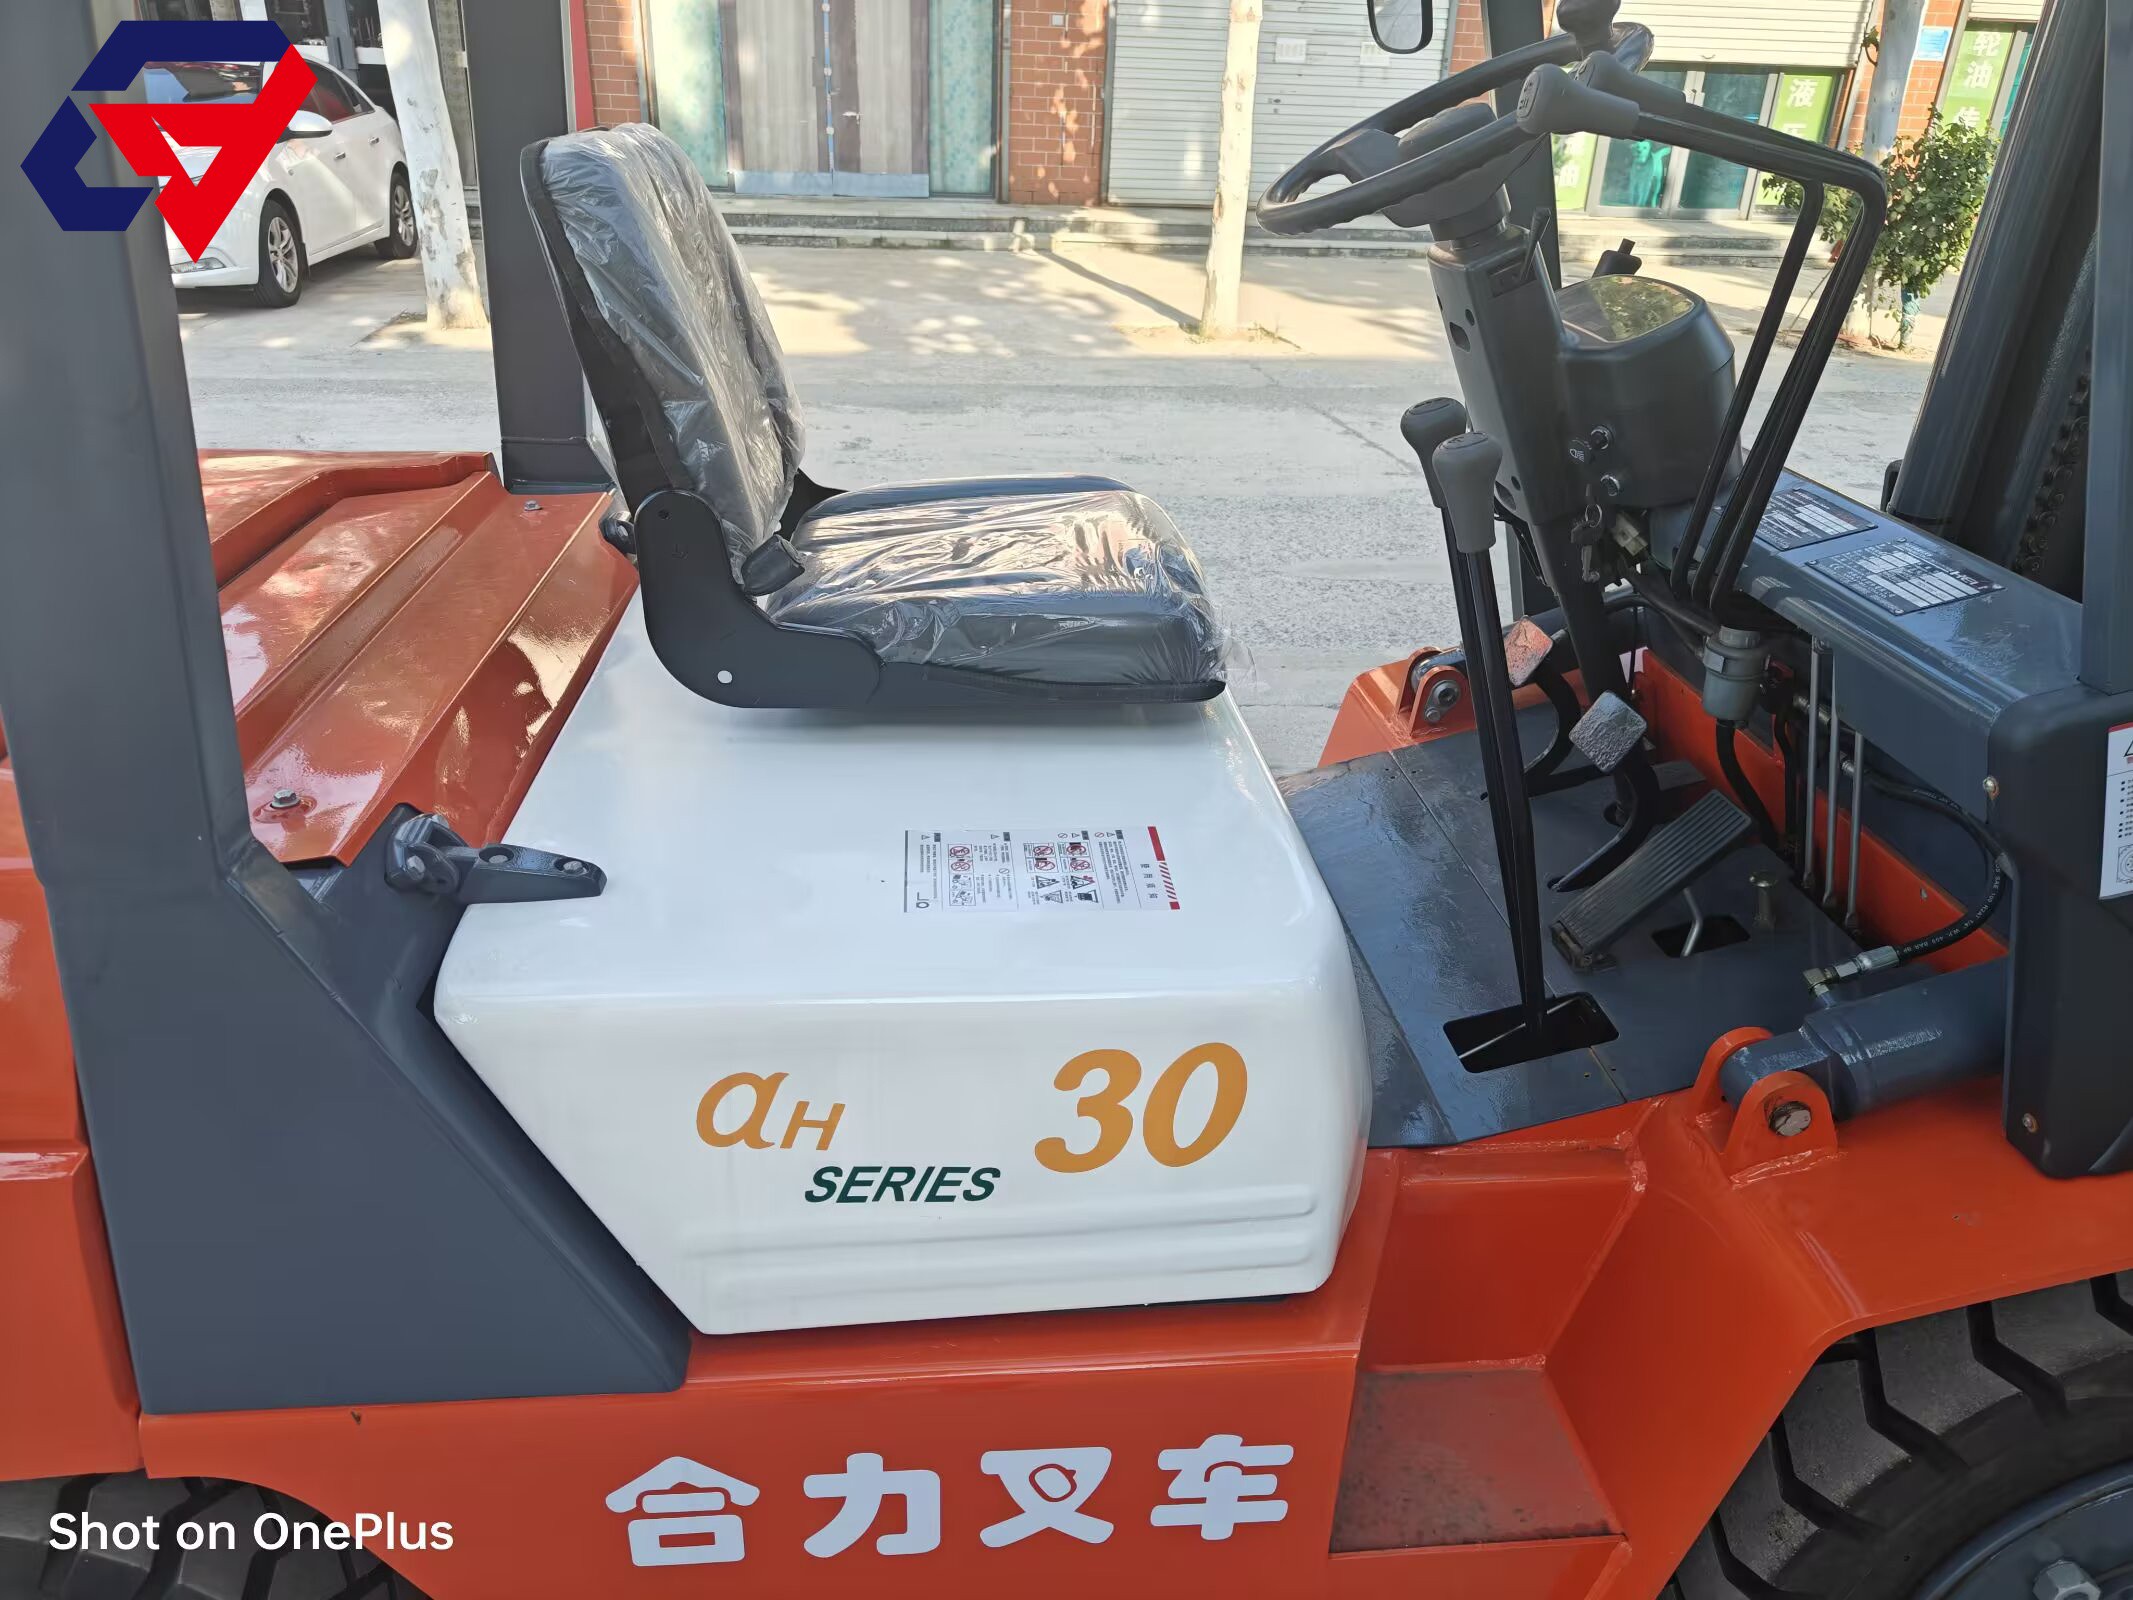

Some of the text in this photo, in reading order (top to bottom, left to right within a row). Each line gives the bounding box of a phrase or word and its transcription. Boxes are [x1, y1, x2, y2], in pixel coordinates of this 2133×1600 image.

[1036, 1044, 1247, 1172] 30
[805, 1166, 1000, 1203] SERIES
[606, 1435, 1293, 1566] 合力叉车
